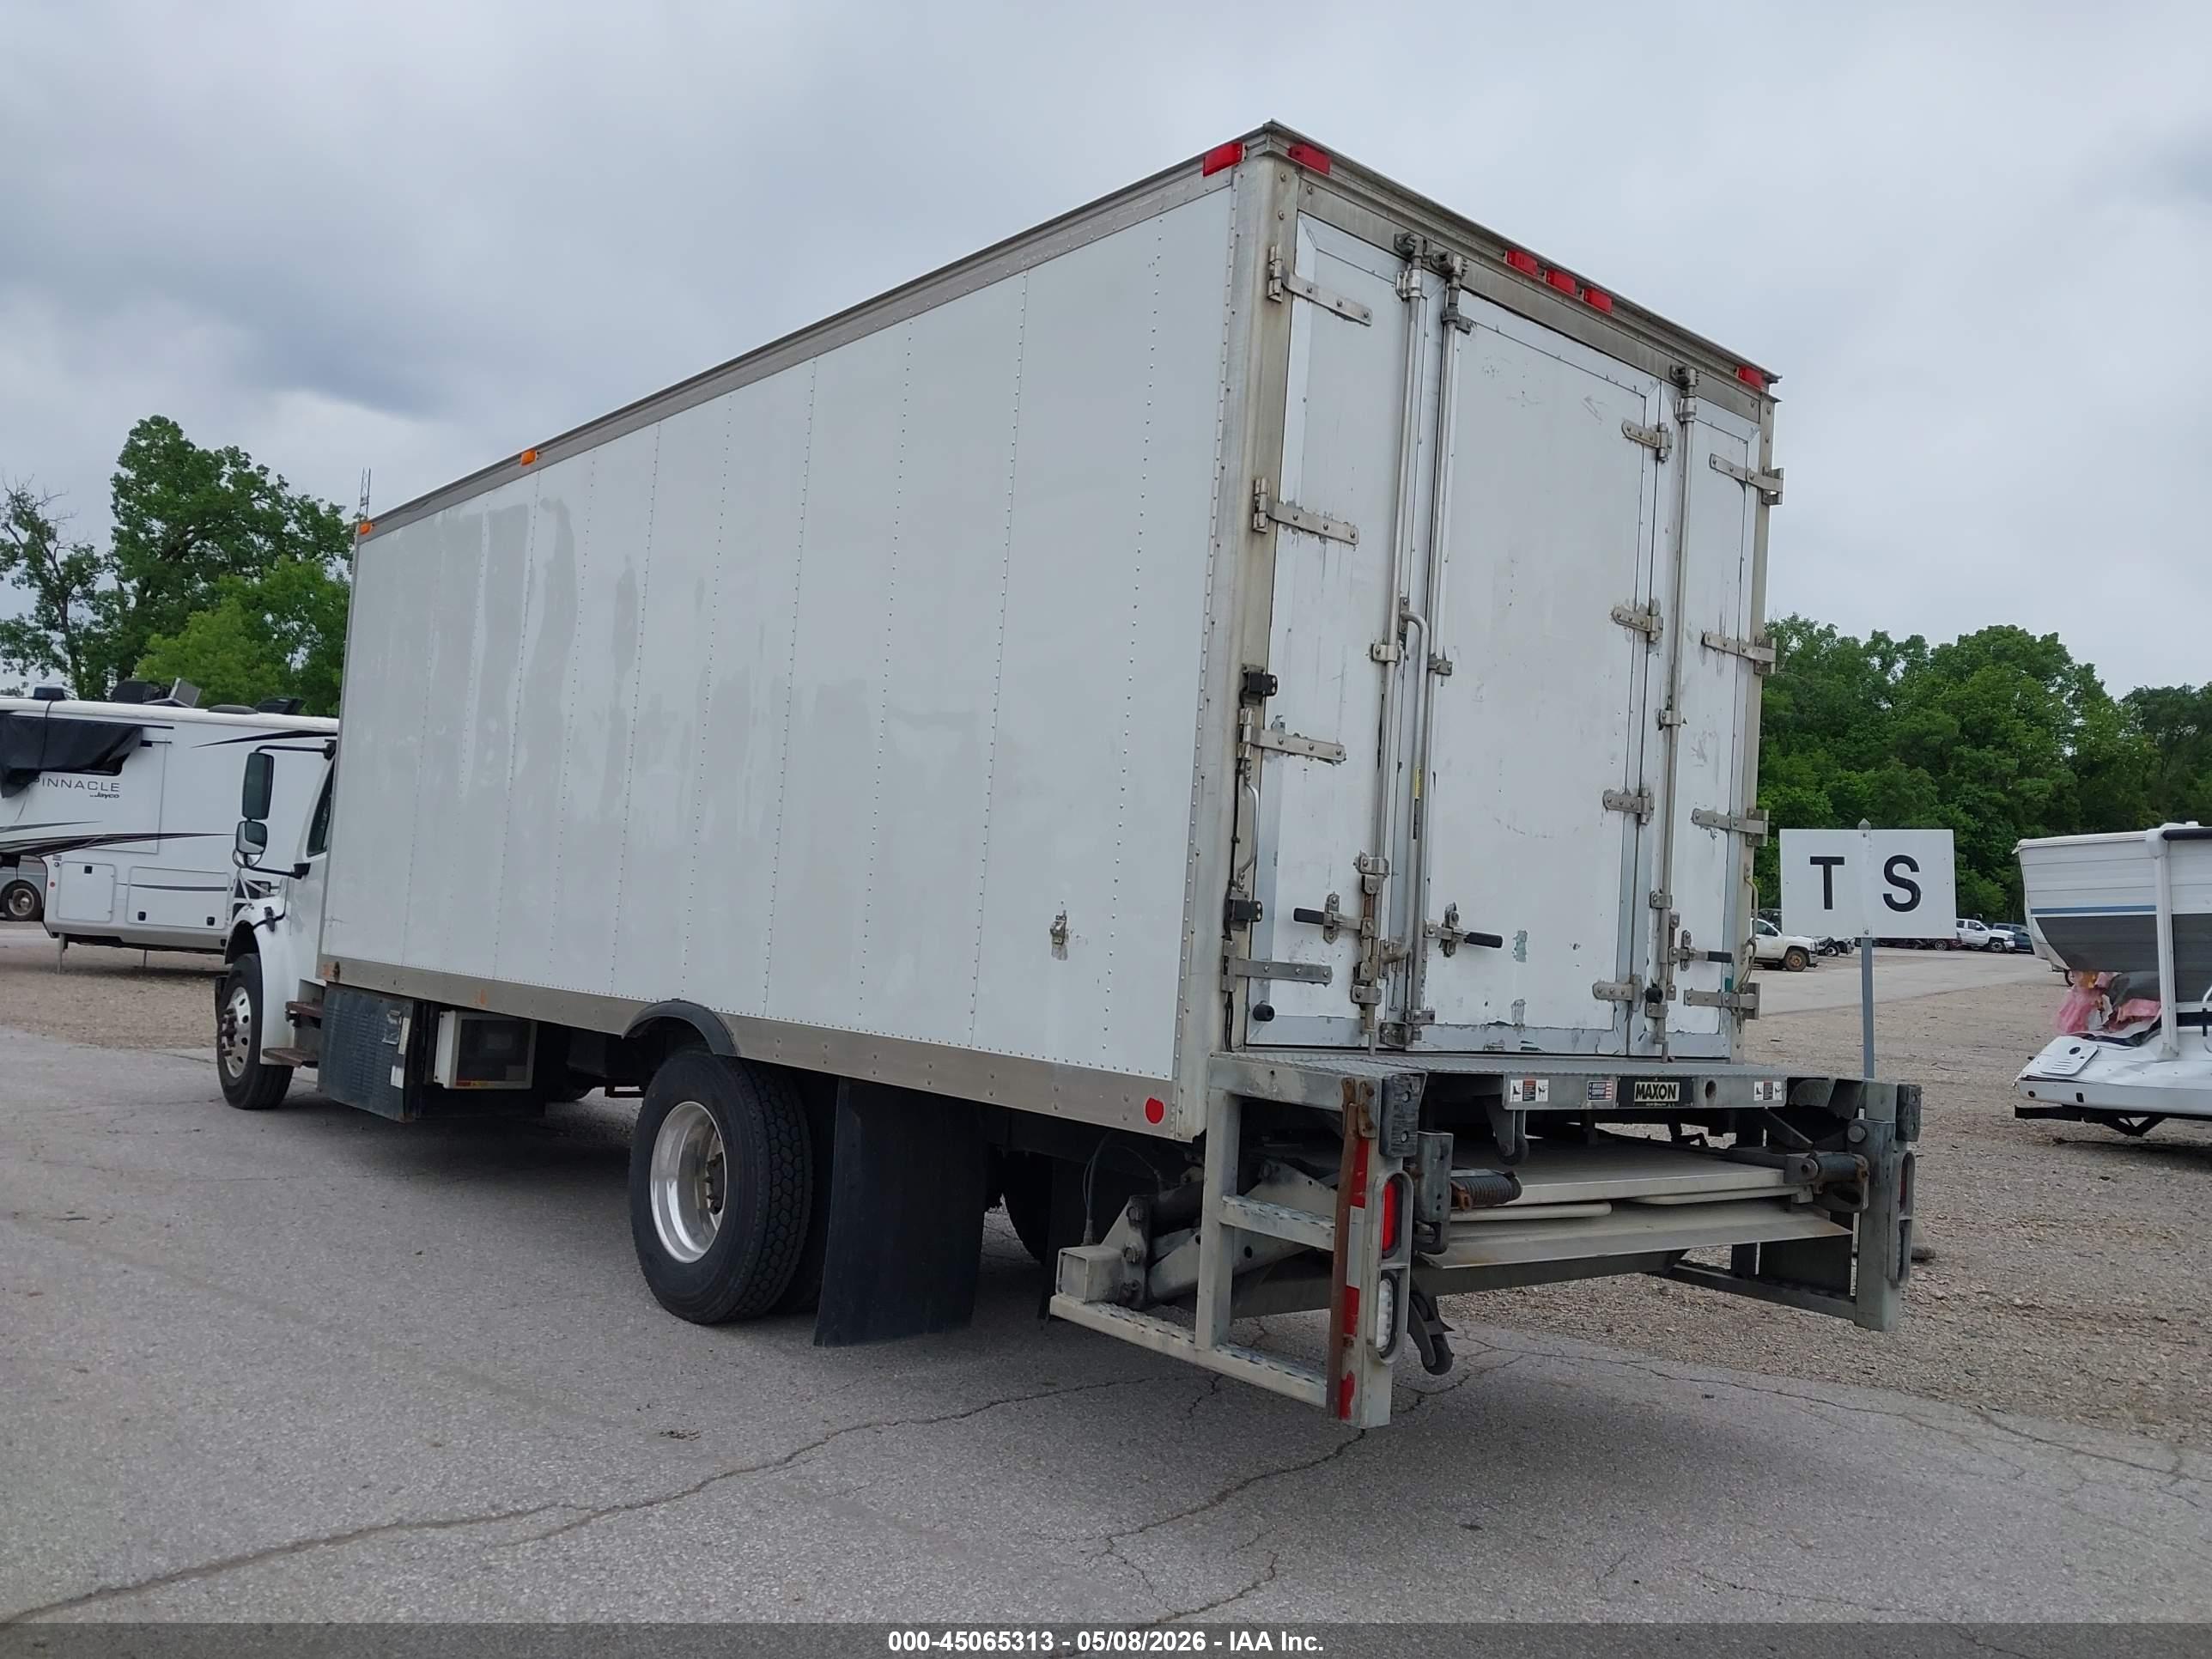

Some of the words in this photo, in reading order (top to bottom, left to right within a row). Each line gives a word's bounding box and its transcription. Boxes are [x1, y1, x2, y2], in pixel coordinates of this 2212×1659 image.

[1810, 856, 1845, 910] T
[1882, 854, 1922, 913] S
[1635, 1084, 1676, 1100] MAXON
